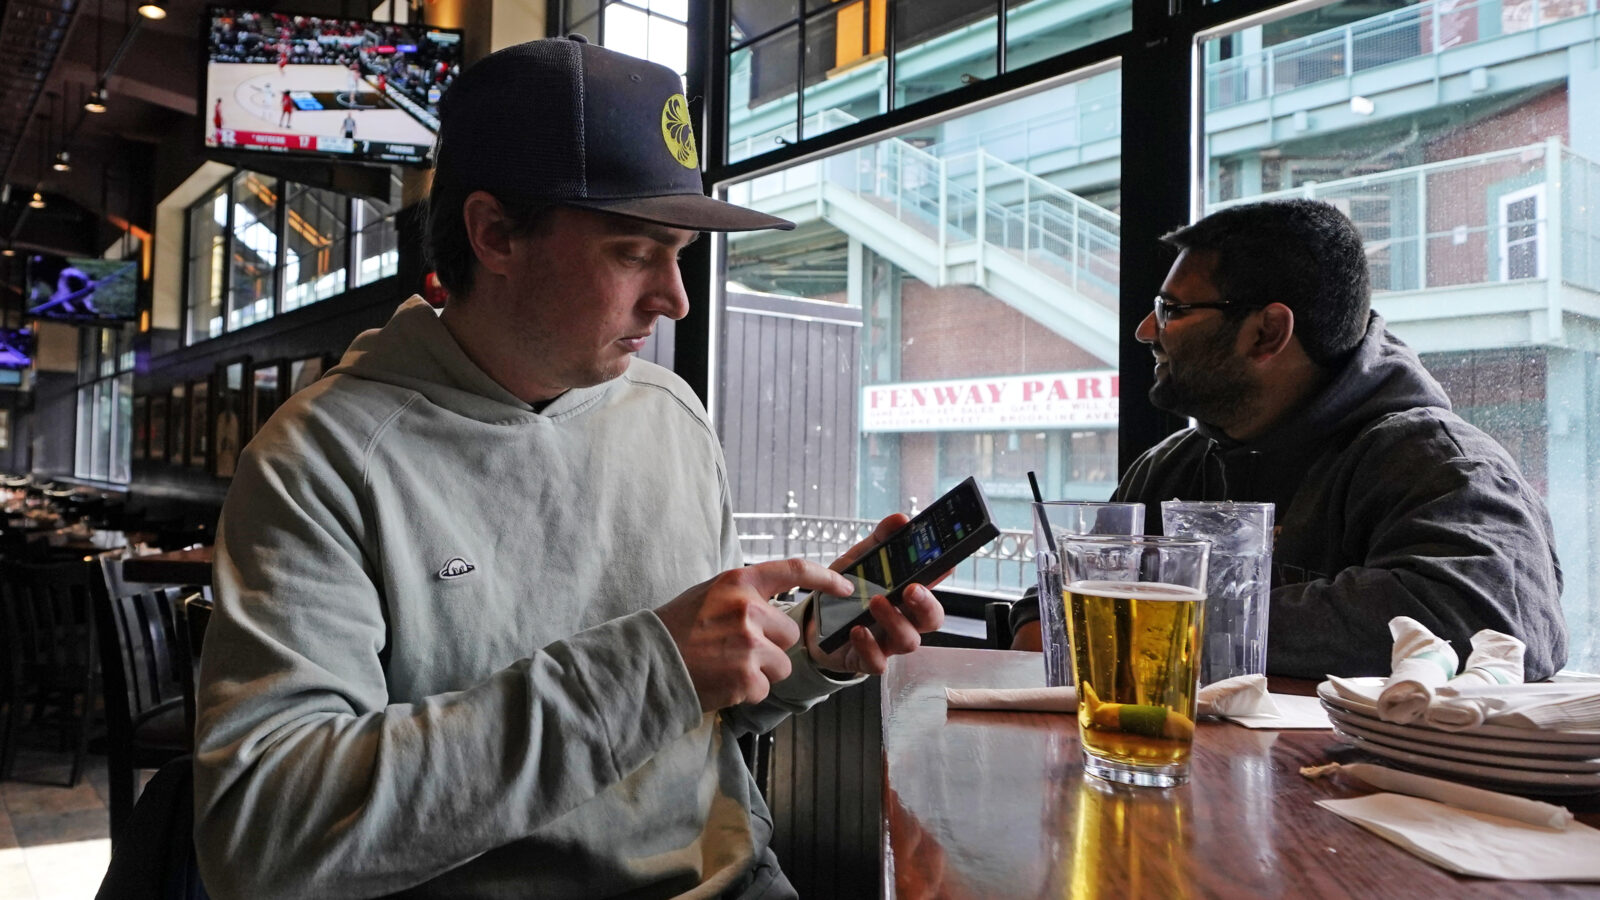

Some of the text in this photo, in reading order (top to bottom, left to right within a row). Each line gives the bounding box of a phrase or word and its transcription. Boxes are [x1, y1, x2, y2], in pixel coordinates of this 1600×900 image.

[871, 385, 1007, 408] FENWAY
[961, 406, 994, 415] SALES
[1010, 404, 1039, 412] GATE
[1071, 401, 1100, 410] WILL
[938, 416, 981, 424] STREET
[1000, 413, 1075, 422] BROOKLINE
